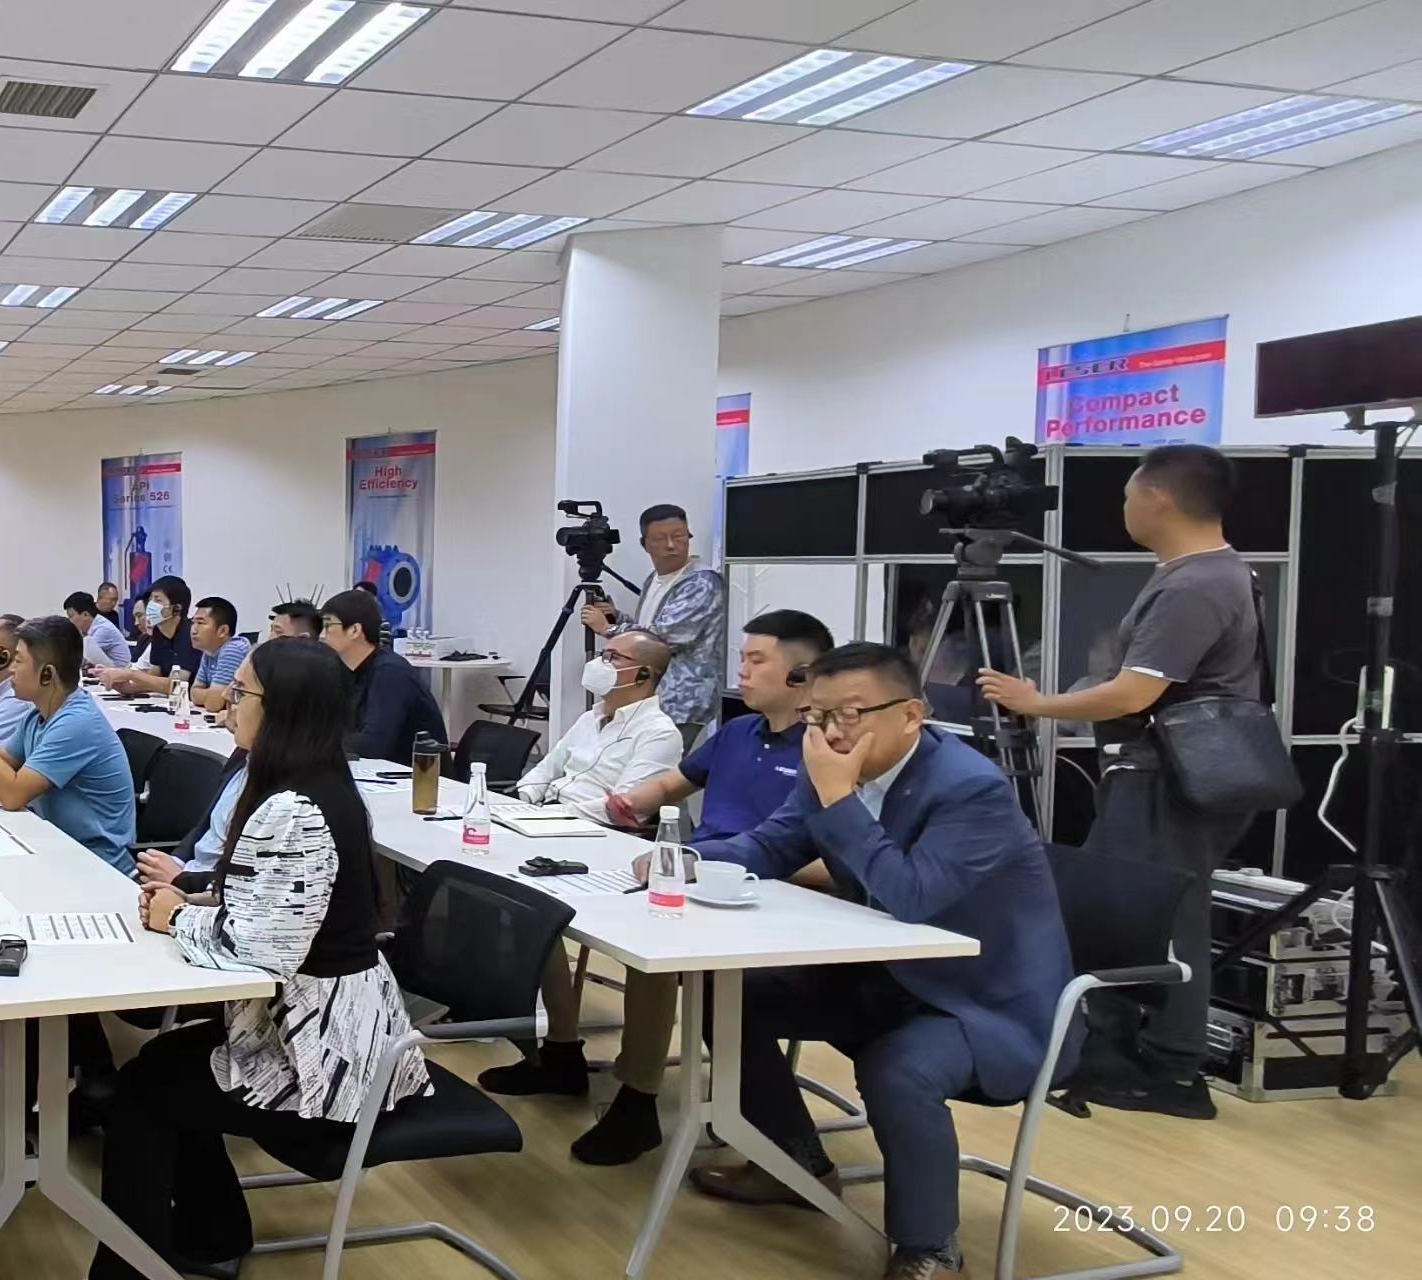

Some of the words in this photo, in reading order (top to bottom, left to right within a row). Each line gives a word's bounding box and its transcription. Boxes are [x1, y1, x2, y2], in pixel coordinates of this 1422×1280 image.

[1069, 384, 1180, 418] Compact
[1046, 407, 1207, 438] Performance
[374, 465, 402, 479] High
[359, 478, 418, 490] Efficiency
[149, 490, 171, 502] 526
